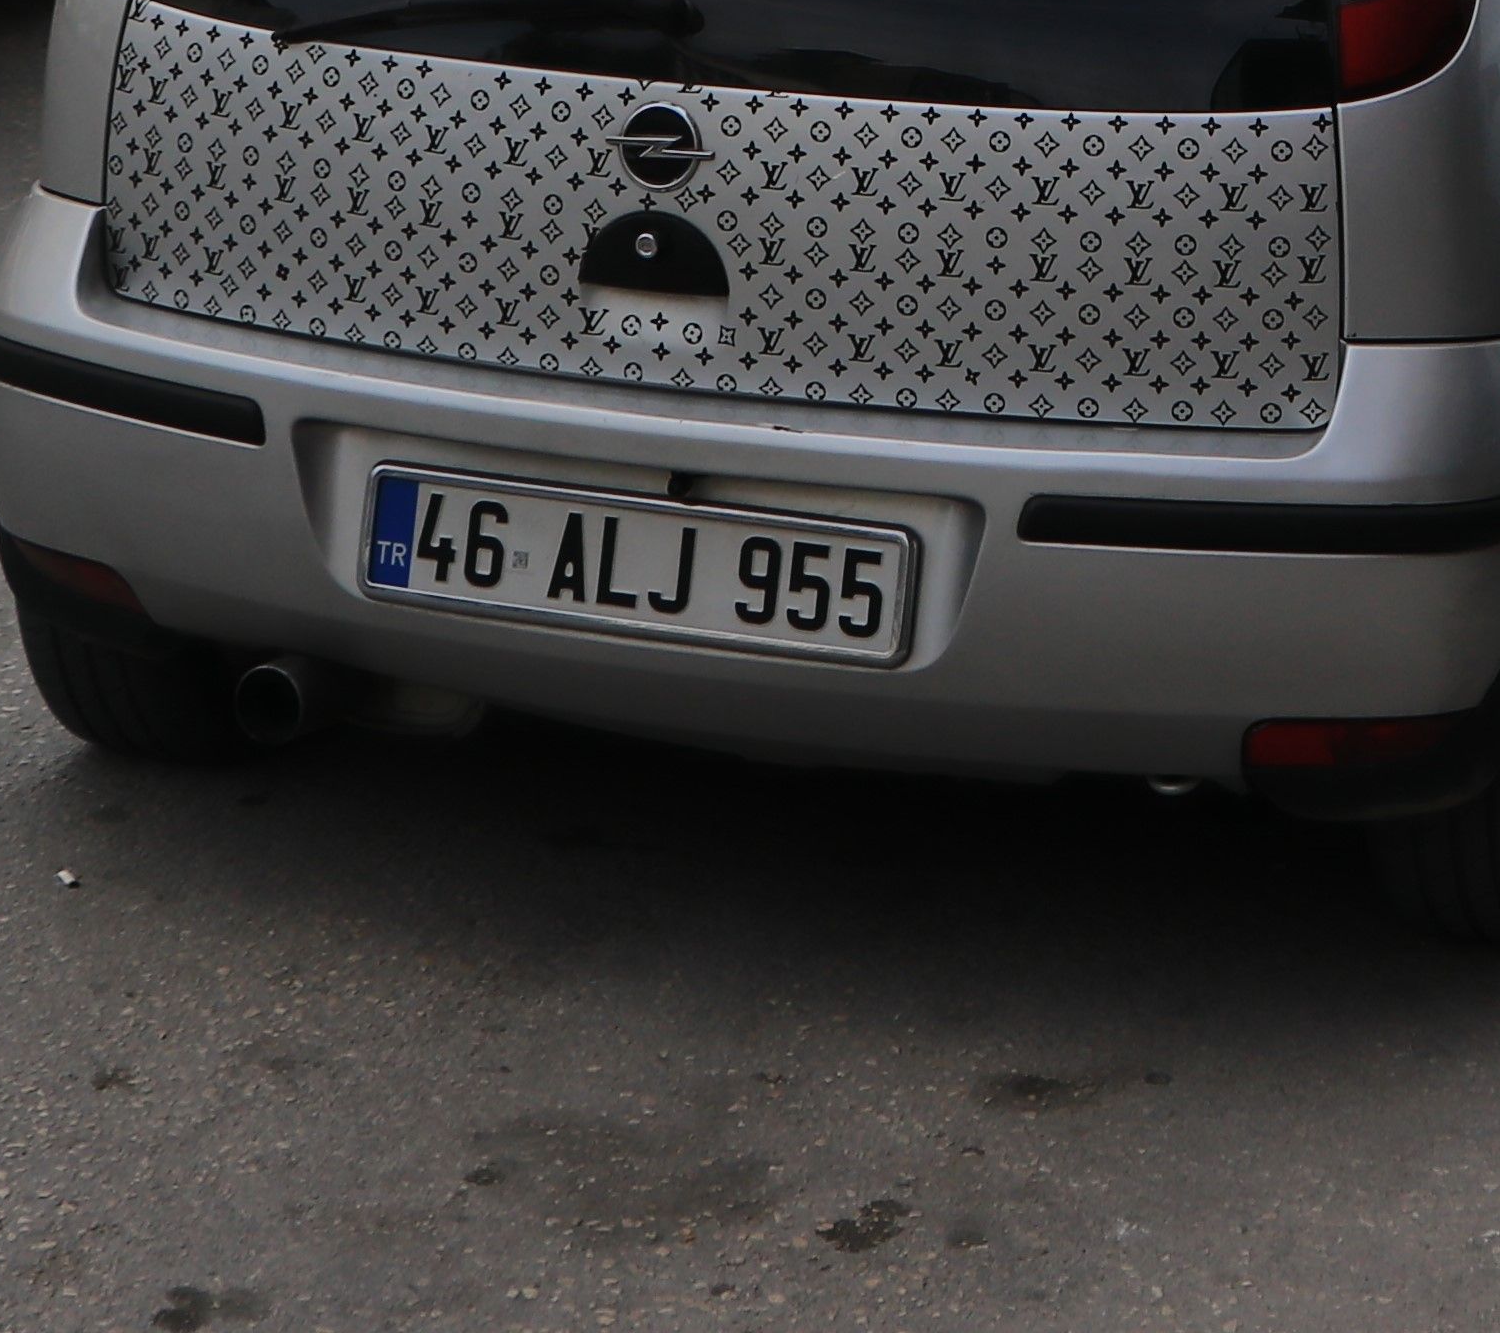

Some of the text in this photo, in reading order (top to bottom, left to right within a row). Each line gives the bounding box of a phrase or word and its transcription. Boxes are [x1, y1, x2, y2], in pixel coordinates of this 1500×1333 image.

[376, 539, 406, 568] TR
[415, 492, 885, 639] 46 ALJ 955
